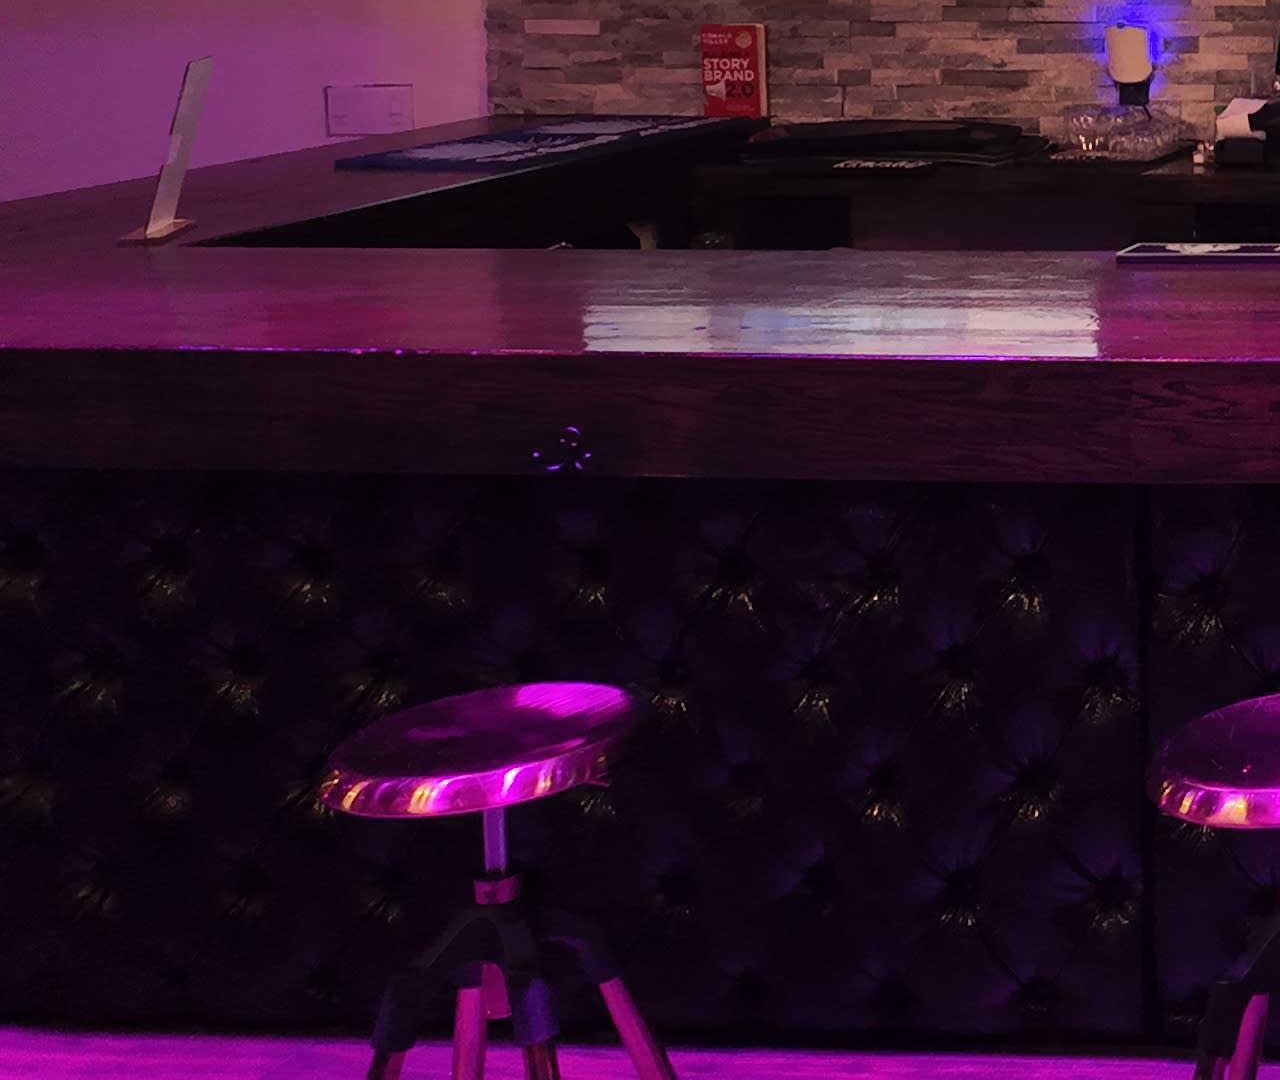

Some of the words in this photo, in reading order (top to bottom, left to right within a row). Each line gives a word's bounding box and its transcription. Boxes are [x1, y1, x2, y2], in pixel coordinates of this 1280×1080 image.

[703, 58, 750, 70] STORY
[703, 70, 755, 82] BRAND
[725, 81, 754, 98] 2.0
